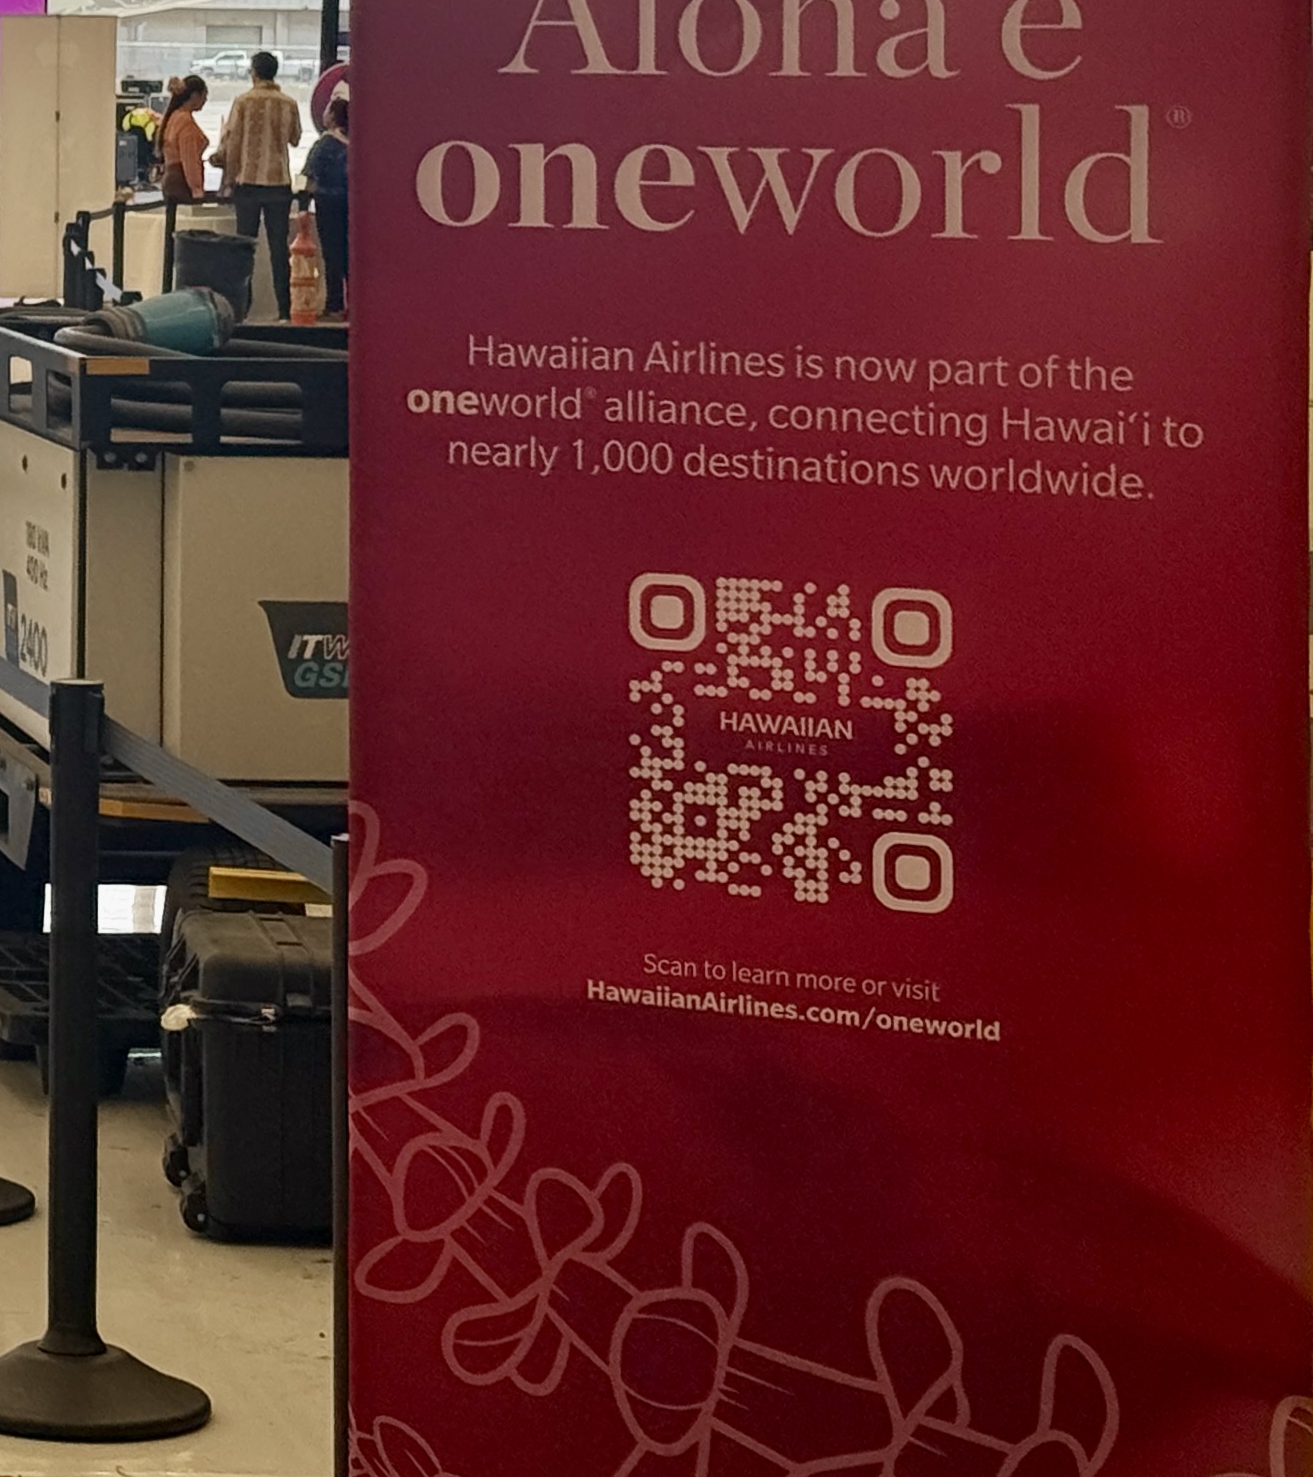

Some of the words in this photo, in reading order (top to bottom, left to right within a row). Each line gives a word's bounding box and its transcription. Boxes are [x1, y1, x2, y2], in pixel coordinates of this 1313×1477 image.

[469, 335, 633, 371] Hawaiian
[644, 341, 785, 377] Airlines
[796, 345, 823, 379] is
[836, 356, 916, 382] now
[929, 356, 1008, 391] part
[1019, 355, 1059, 388] of
[1067, 357, 1133, 391] the
[605, 390, 757, 431] alliance,
[769, 402, 987, 446] connecting
[1163, 417, 1203, 447] to
[449, 436, 558, 476] nearly
[573, 439, 673, 474] 1,000
[684, 444, 919, 487] destinations
[930, 459, 1153, 499] worldwide.
[21, 613, 48, 678] 2400
[287, 634, 350, 660] ITW
[721, 712, 852, 739] HAWAIIAN
[745, 739, 827, 756] AIRLINES
[644, 953, 697, 977] Scan
[704, 961, 726, 980] to
[732, 961, 789, 986] learn
[797, 973, 856, 993] more
[862, 979, 887, 995] or
[892, 978, 939, 1002] visit
[588, 972, 1000, 1041] HawaiianAirlines.com/oneworld
